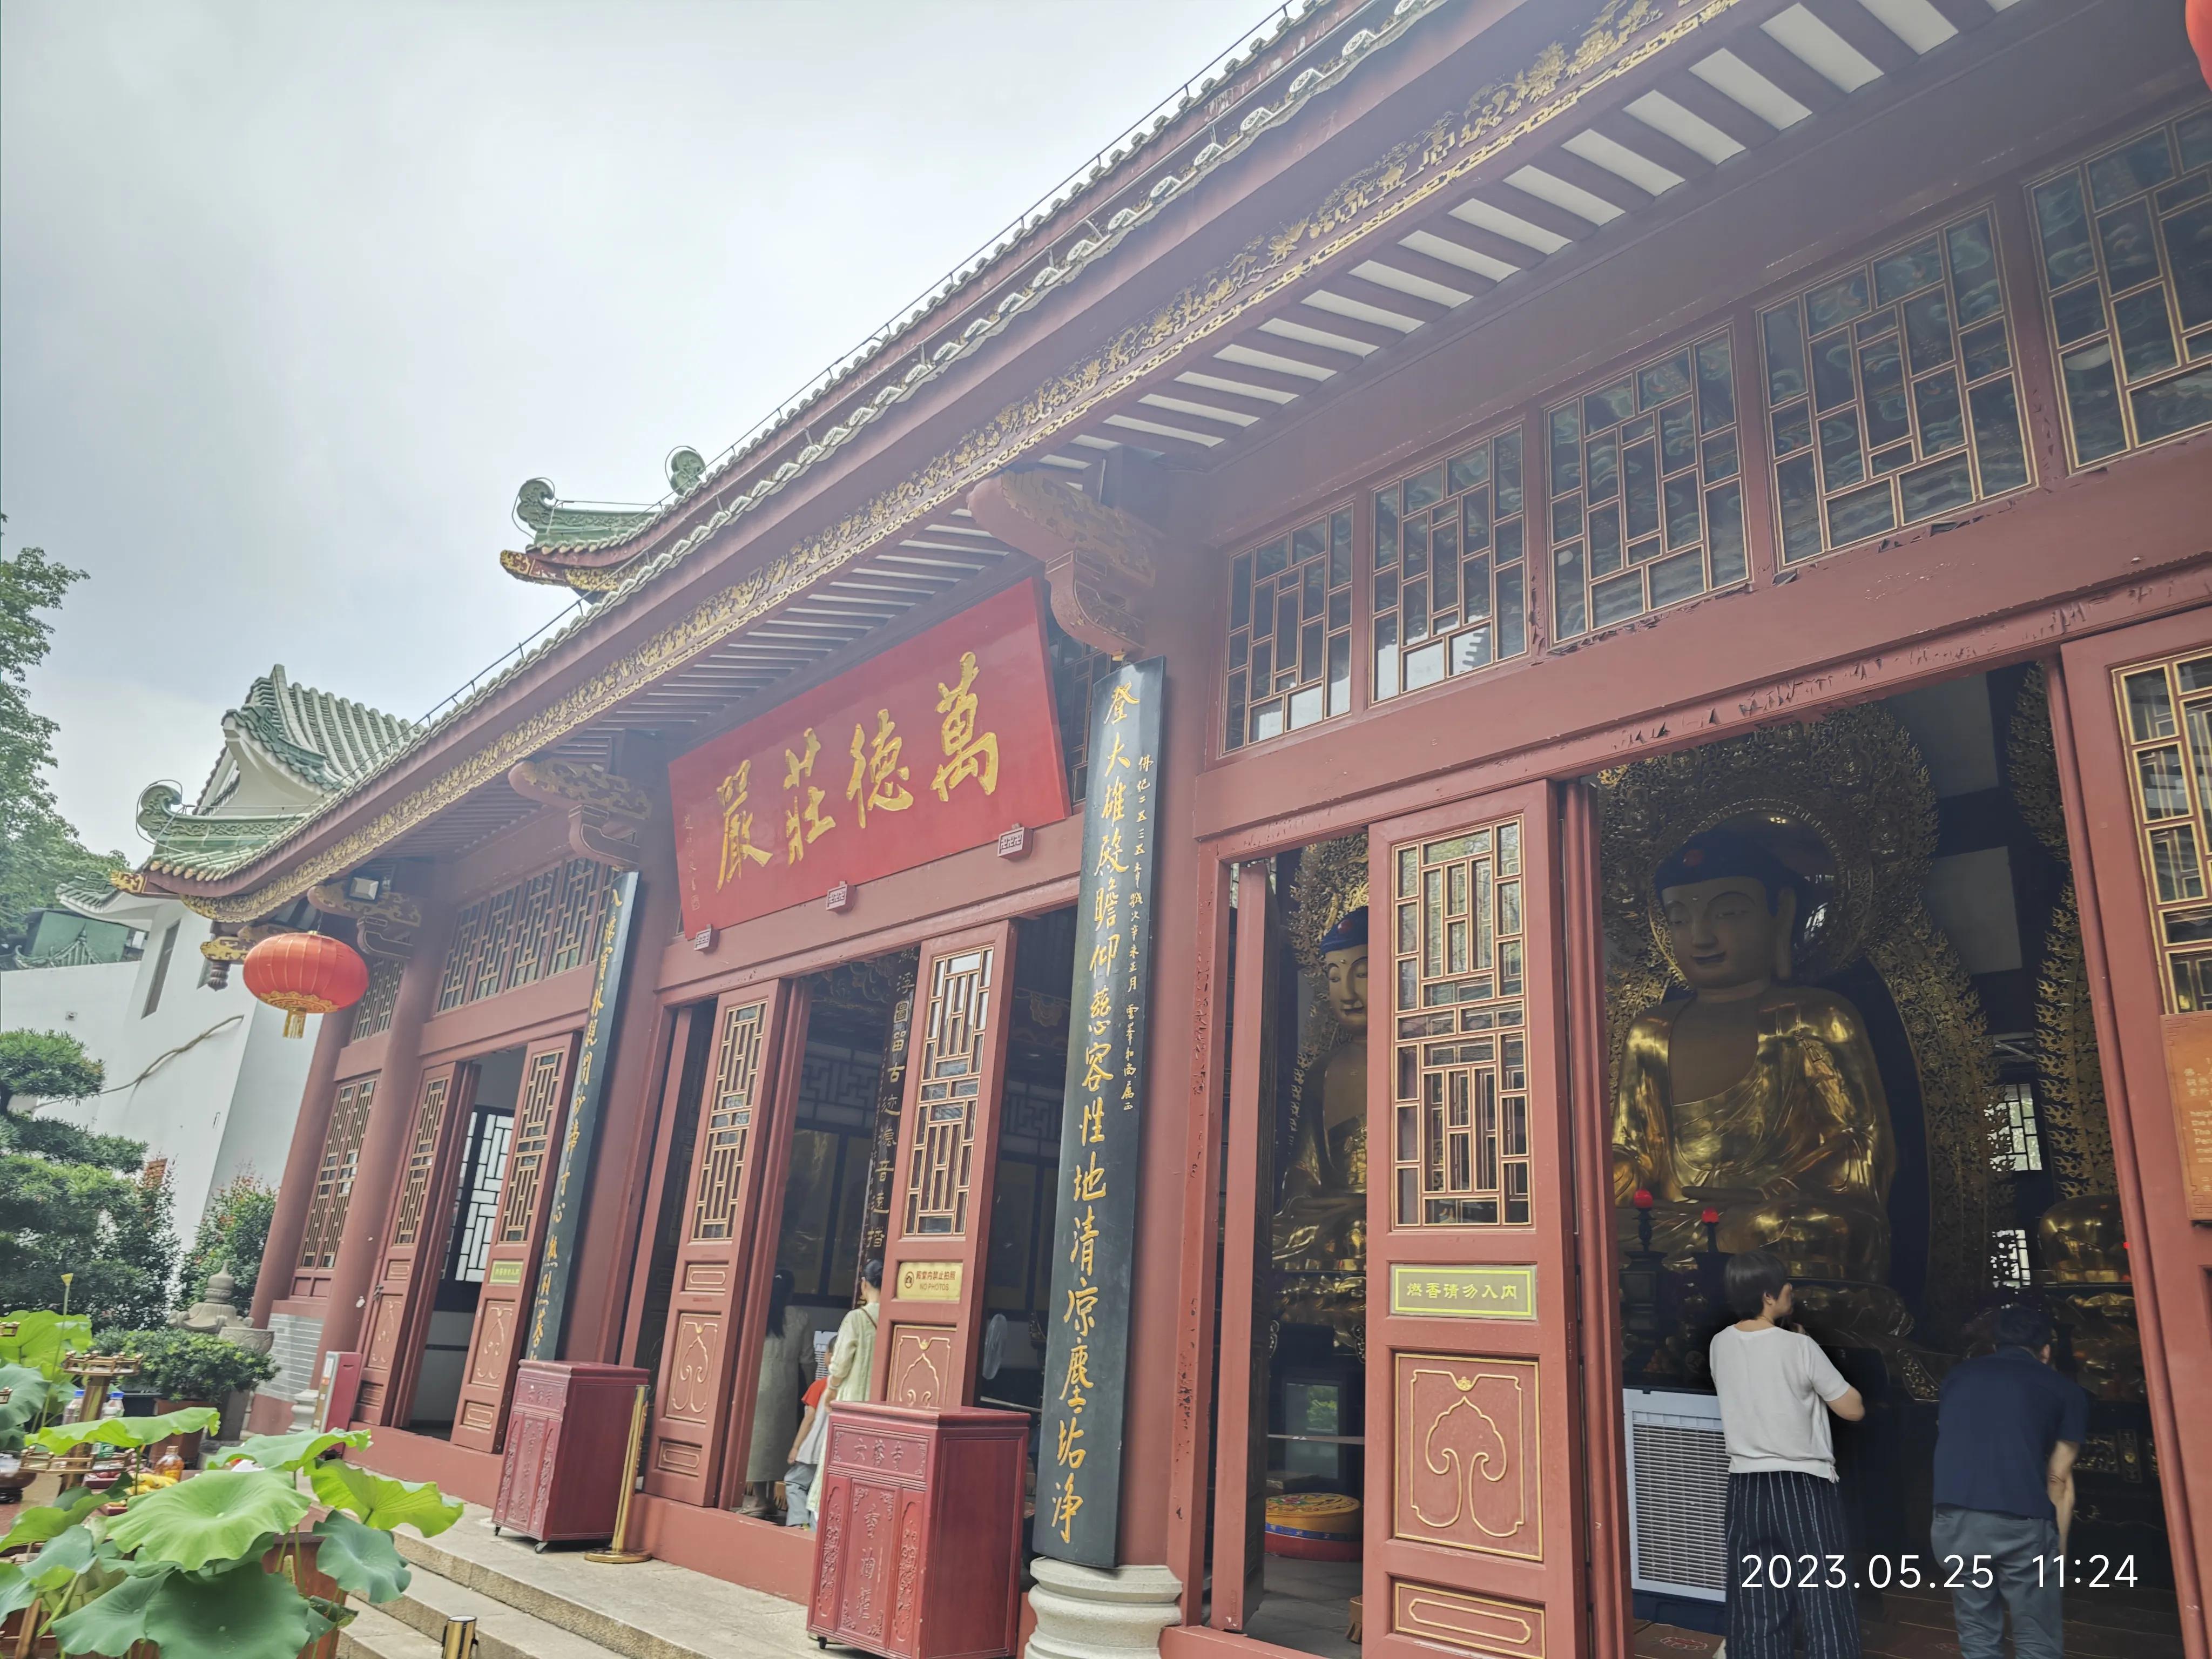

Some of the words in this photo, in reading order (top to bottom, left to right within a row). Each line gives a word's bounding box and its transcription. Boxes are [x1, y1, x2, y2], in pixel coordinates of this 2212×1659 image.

[928, 1283, 949, 1291] PHOTOS
[1407, 1283, 1518, 1300] 燃香请勿入内
